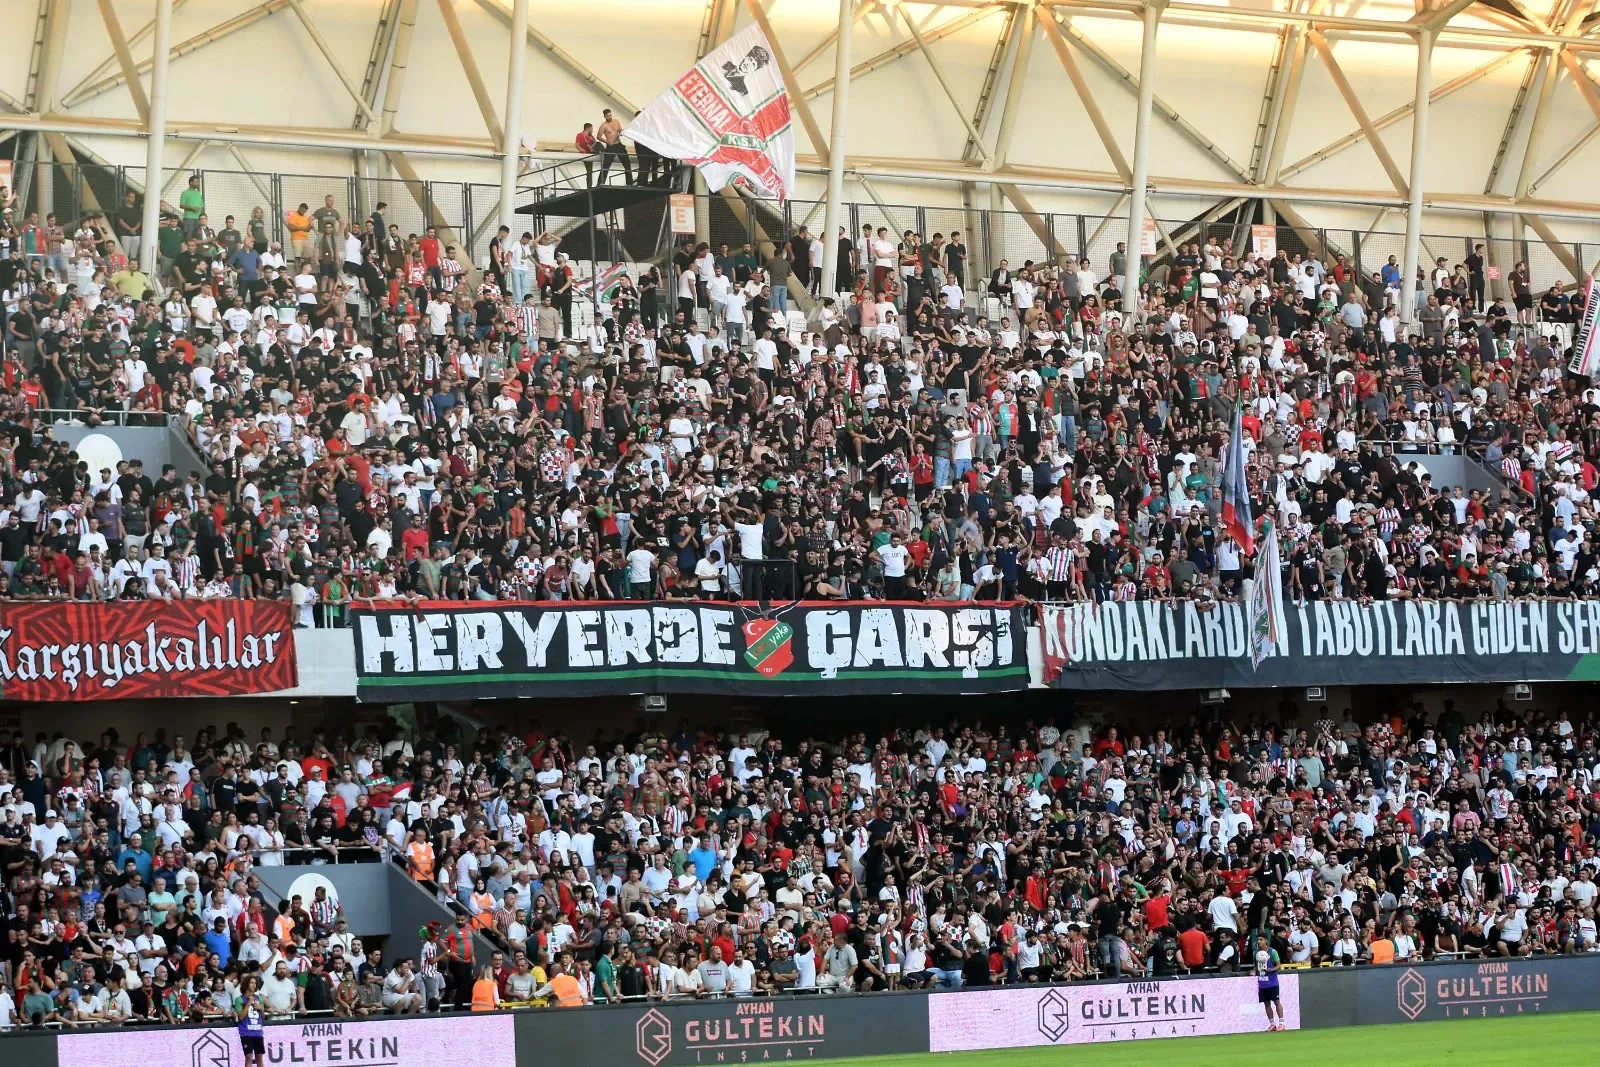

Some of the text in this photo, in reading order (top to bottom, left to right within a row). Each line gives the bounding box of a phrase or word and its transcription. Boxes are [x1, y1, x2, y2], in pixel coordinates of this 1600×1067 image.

[679, 71, 732, 133] ETERNAL
[1259, 239, 1269, 252] F
[1043, 600, 1289, 663] KUNDAKLARDN
[1292, 599, 1466, 657] TABUTLARA
[359, 607, 1013, 679] HERYERDE ÇARŞI
[1478, 962, 1508, 975] AYHAN
[1126, 982, 1160, 995] AYHAN
[1437, 973, 1548, 998] GÜLTEKİN
[736, 1001, 774, 1015] AYHAN
[1082, 993, 1205, 1019] GÜLTEKİN
[1446, 1002, 1540, 1017] İNŞAAT
[301, 1023, 343, 1037] AYHAN
[685, 1014, 825, 1041] GÜLTEKİN
[1092, 1025, 1196, 1039] İNŞAAT
[254, 1036, 399, 1065] ÜLTEKİN
[697, 1047, 814, 1062] İNŞAAT
